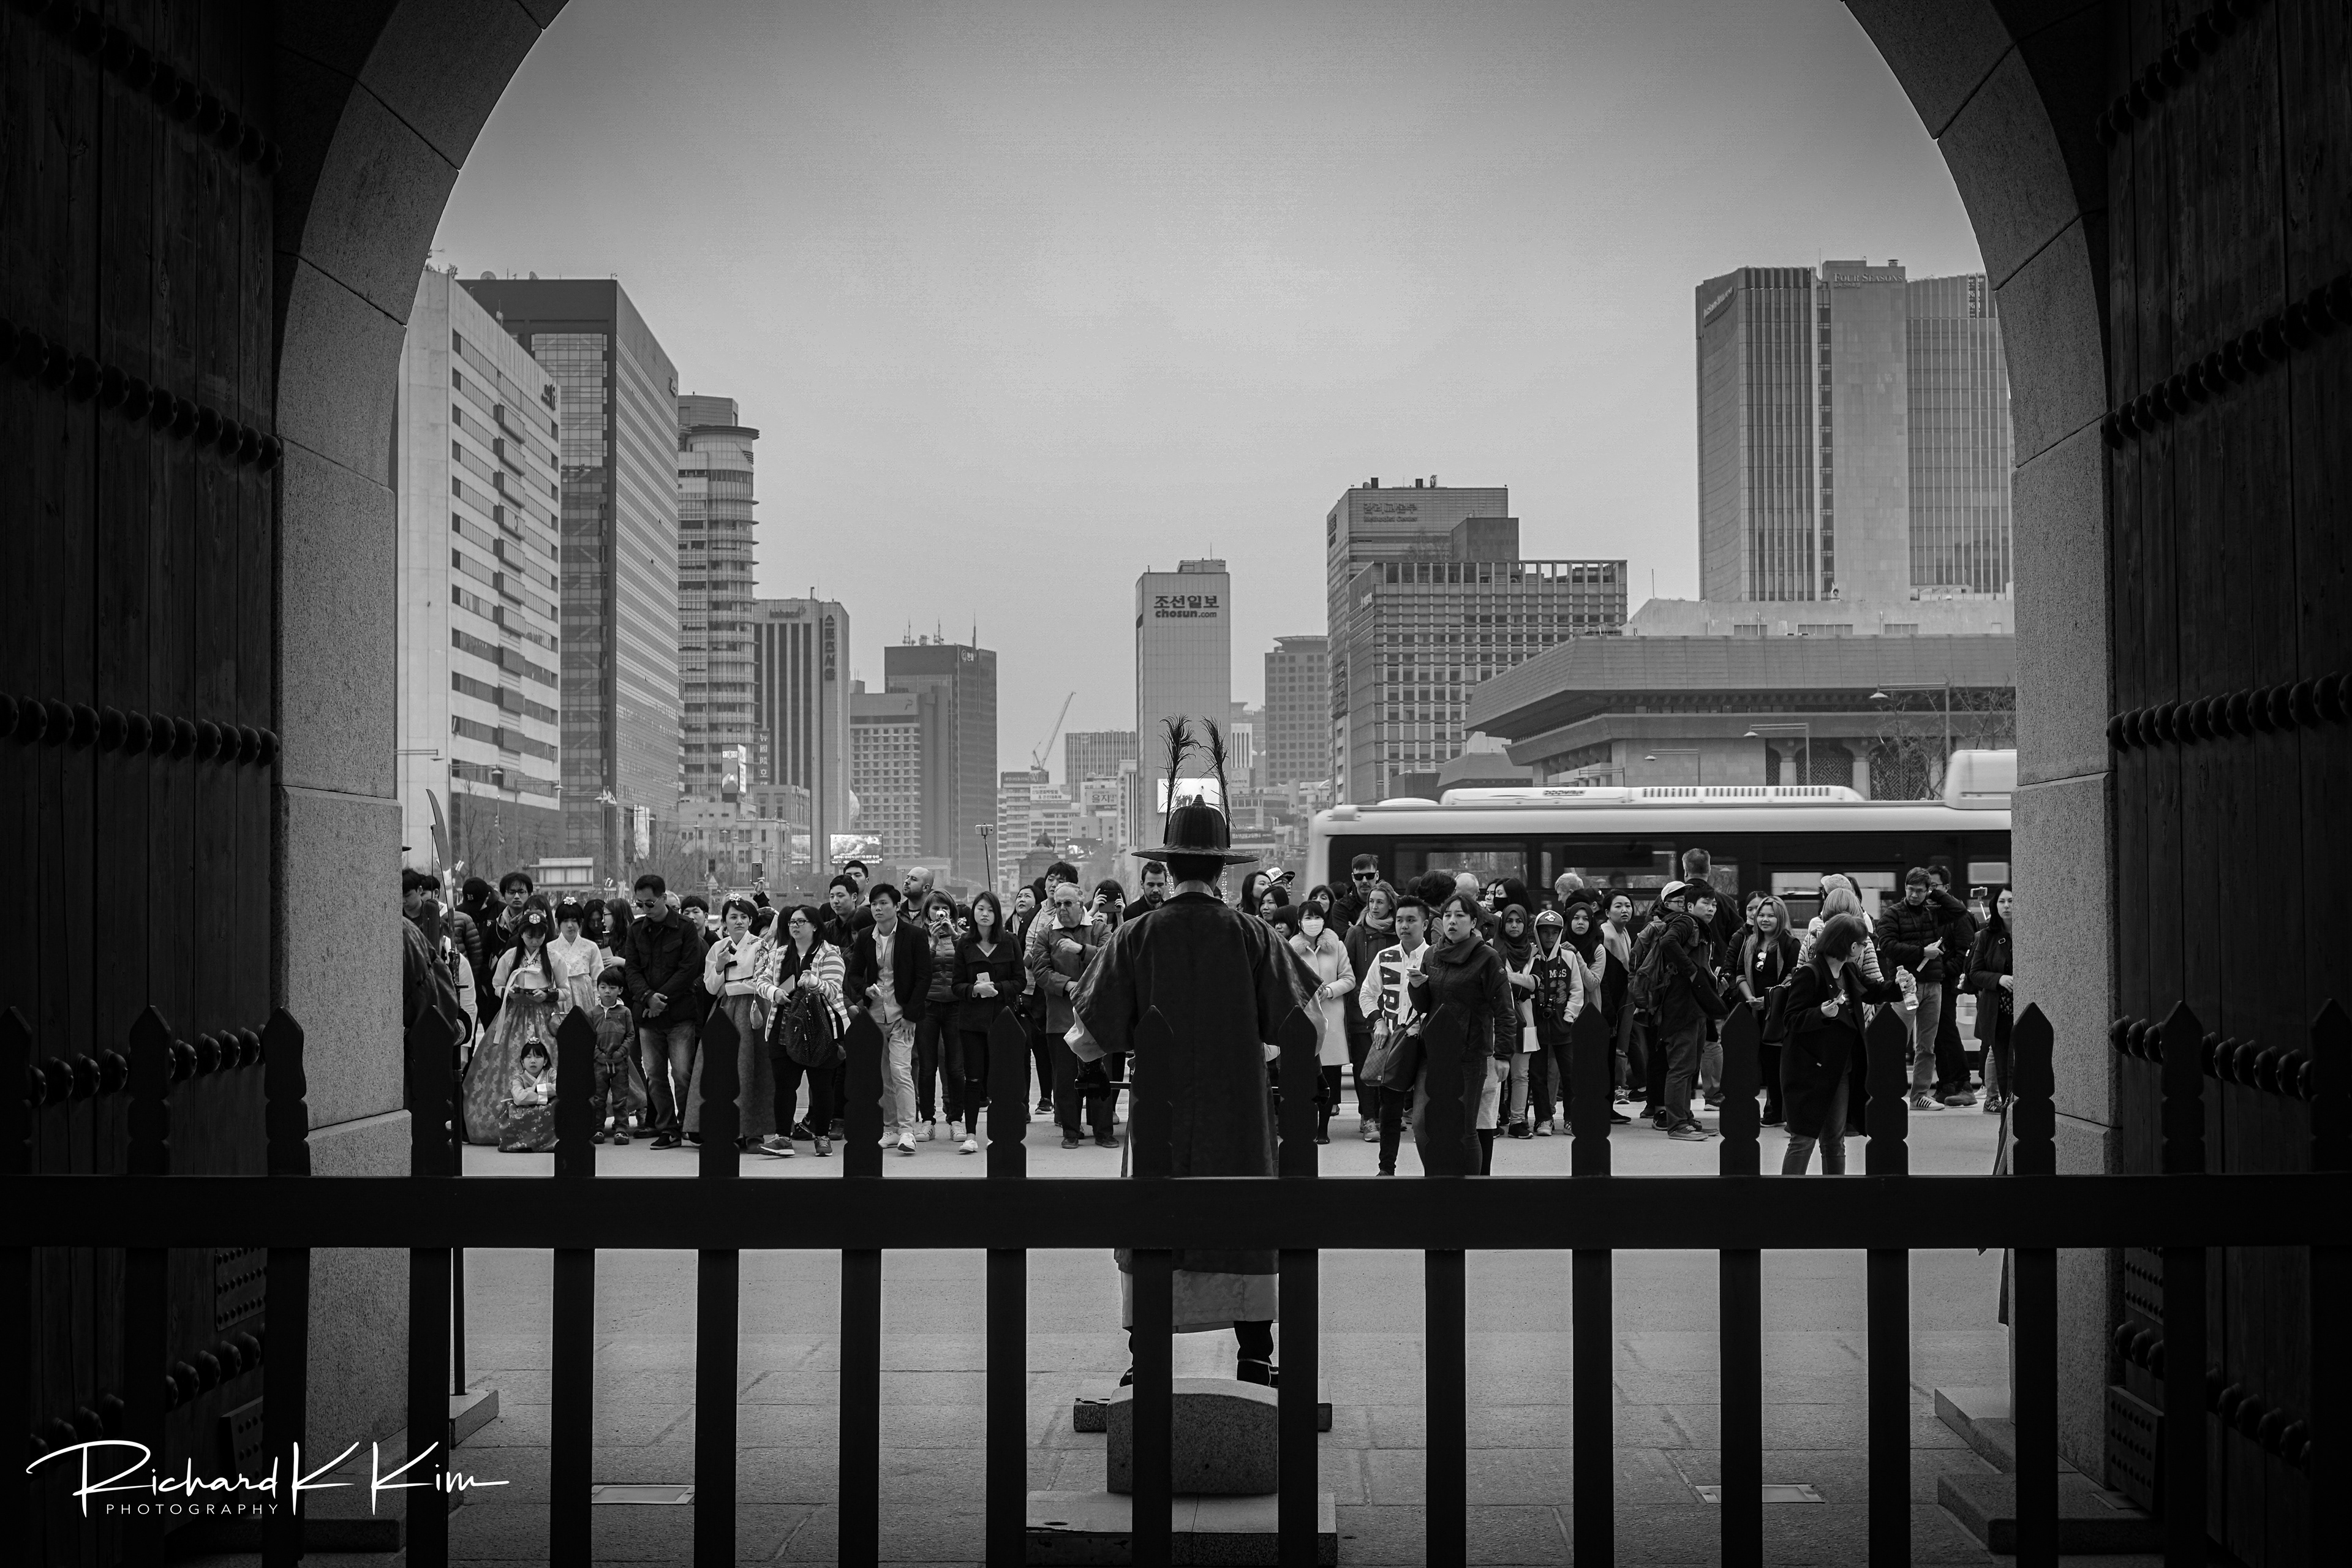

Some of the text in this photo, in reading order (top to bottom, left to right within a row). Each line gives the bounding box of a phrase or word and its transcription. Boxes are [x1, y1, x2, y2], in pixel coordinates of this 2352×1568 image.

[1834, 273, 1903, 282] FOUR SEASONS
[1153, 595, 1219, 608] 조선일보
[1155, 609, 1217, 618] chosun.com
